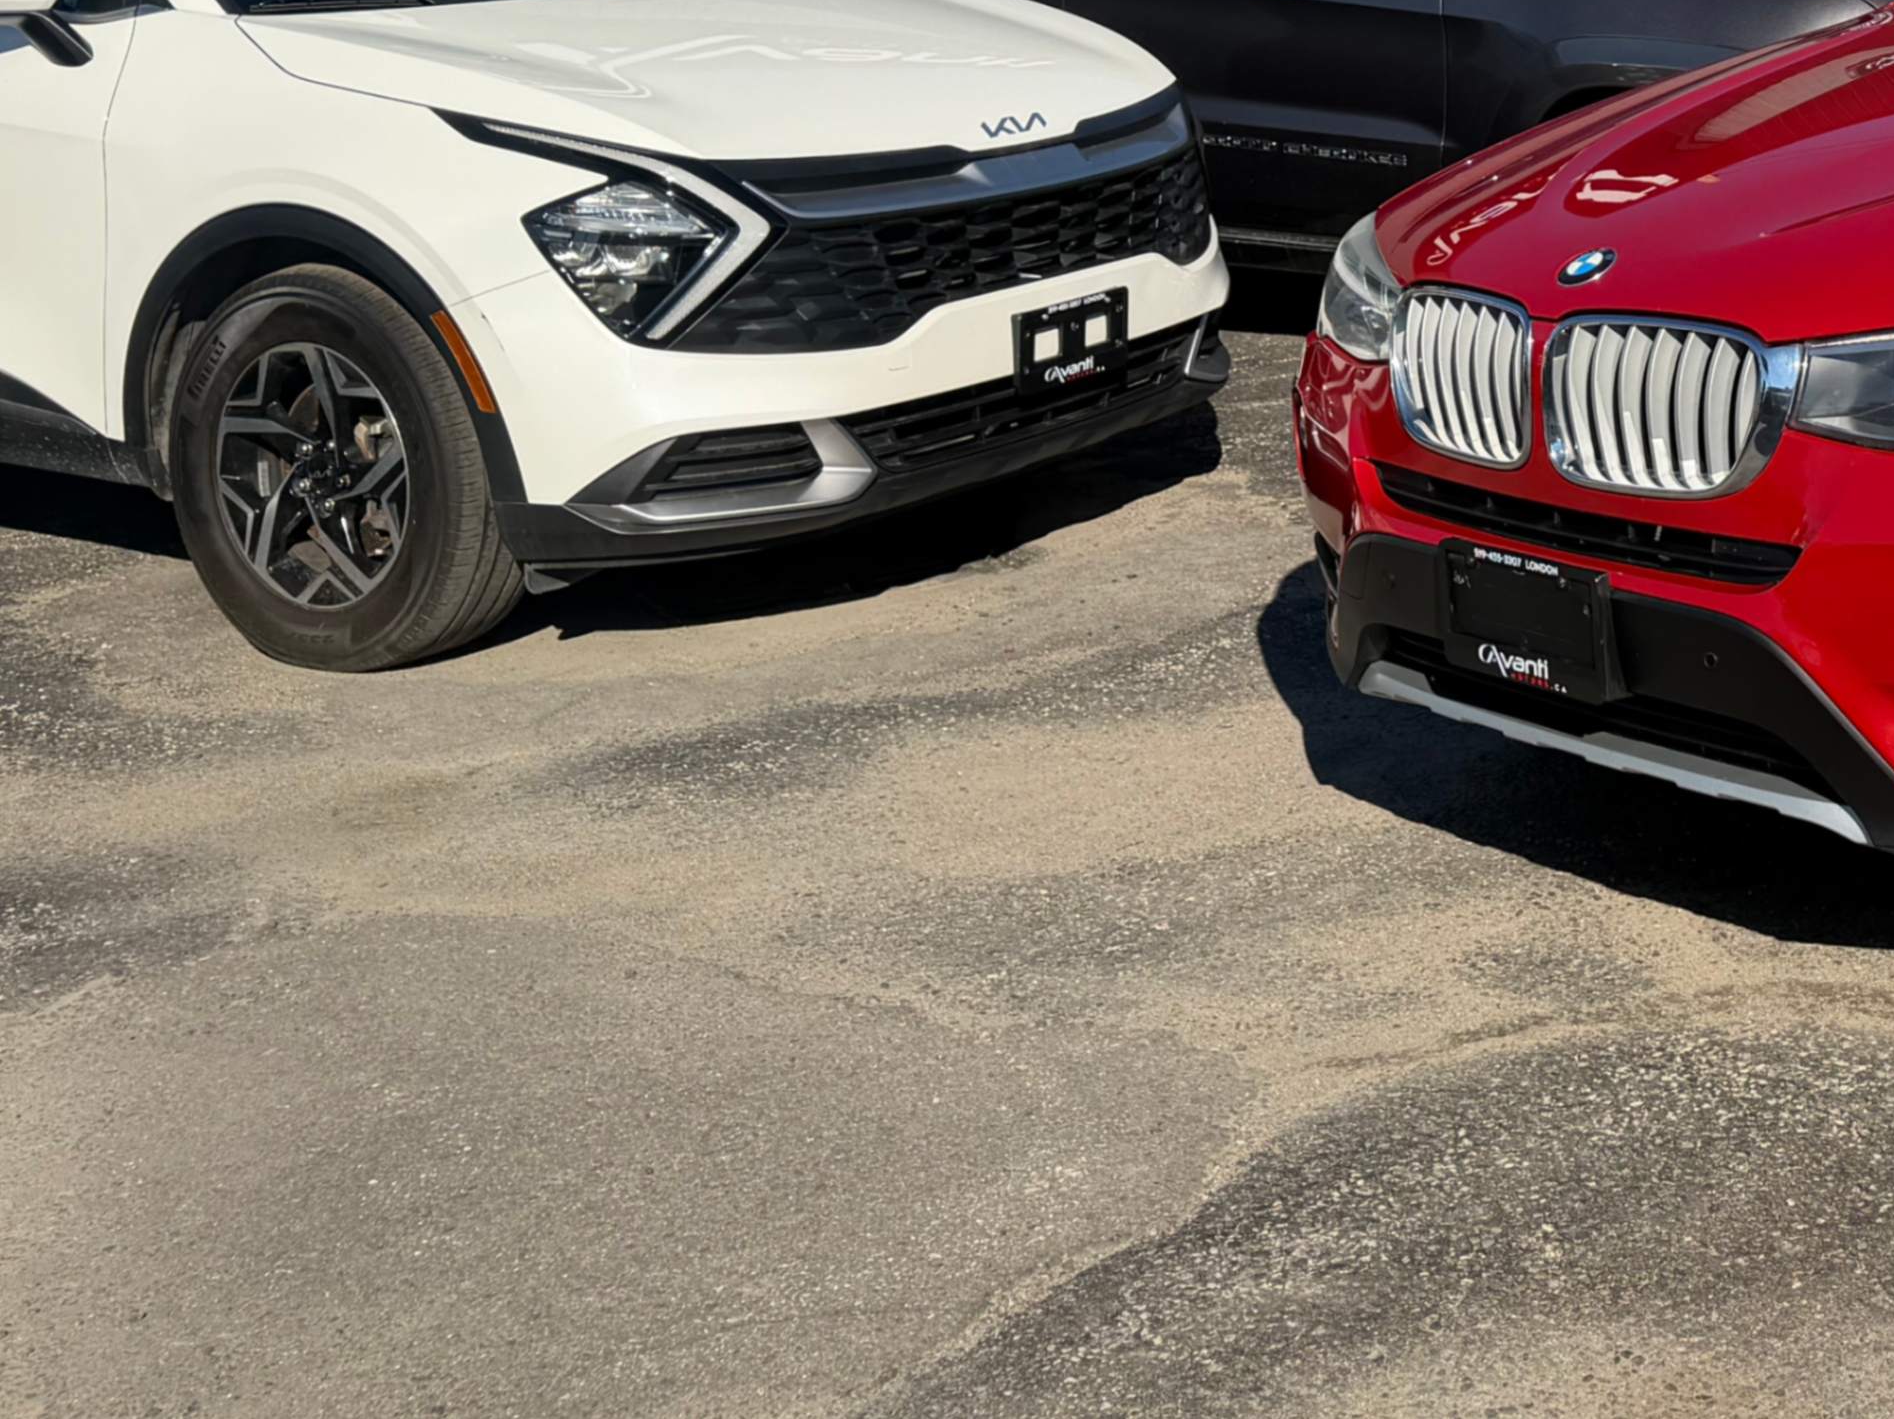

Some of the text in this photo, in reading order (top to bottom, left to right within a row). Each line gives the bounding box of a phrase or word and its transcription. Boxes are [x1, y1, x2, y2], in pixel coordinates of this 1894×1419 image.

[981, 112, 1047, 138] KIA
[1044, 354, 1095, 383] Avanti
[1524, 559, 1559, 576] LONDON
[1478, 643, 1549, 680] Avanti
